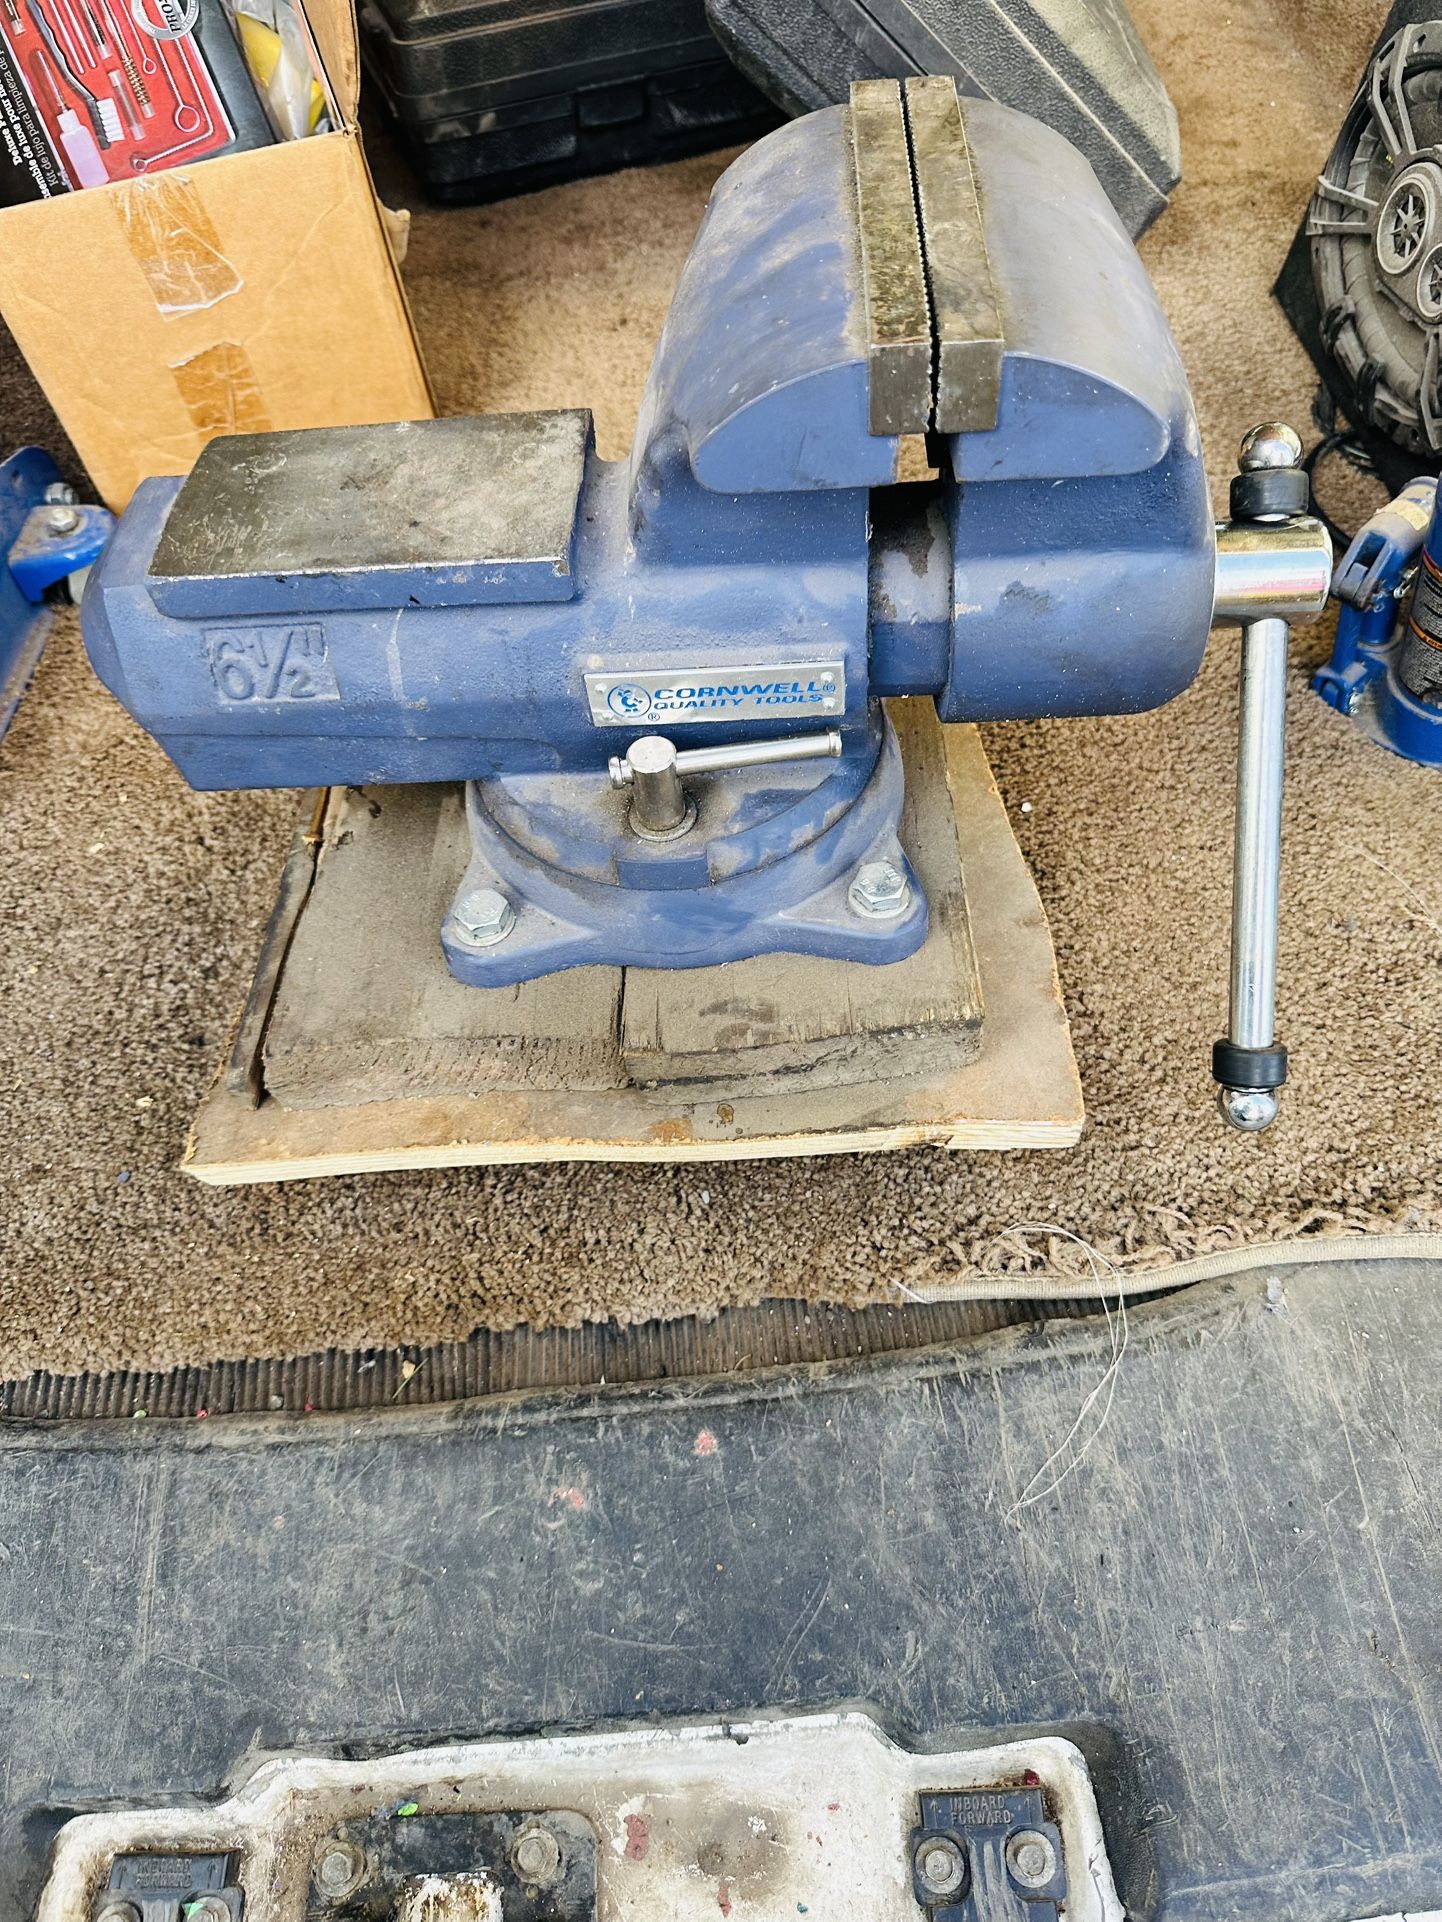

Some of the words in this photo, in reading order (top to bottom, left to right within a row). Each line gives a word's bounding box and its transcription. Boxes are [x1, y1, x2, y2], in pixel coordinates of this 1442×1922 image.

[4, 70, 28, 115] limpieza
[2, 98, 20, 123] pour
[13, 122, 28, 147] luxe
[22, 112, 39, 137] para
[2, 127, 23, 166] Deluxe
[22, 145, 34, 159] de
[32, 136, 47, 158] lujo
[41, 156, 52, 170] de
[29, 159, 52, 199] nsemble
[45, 169, 59, 187] Kit
[653, 681, 823, 700] CORNWELL
[653, 698, 744, 711] QUALITY
[754, 693, 824, 705] TOOLS
[950, 1795, 1006, 1811] INBOARD
[950, 1810, 1012, 1826] FORWARD
